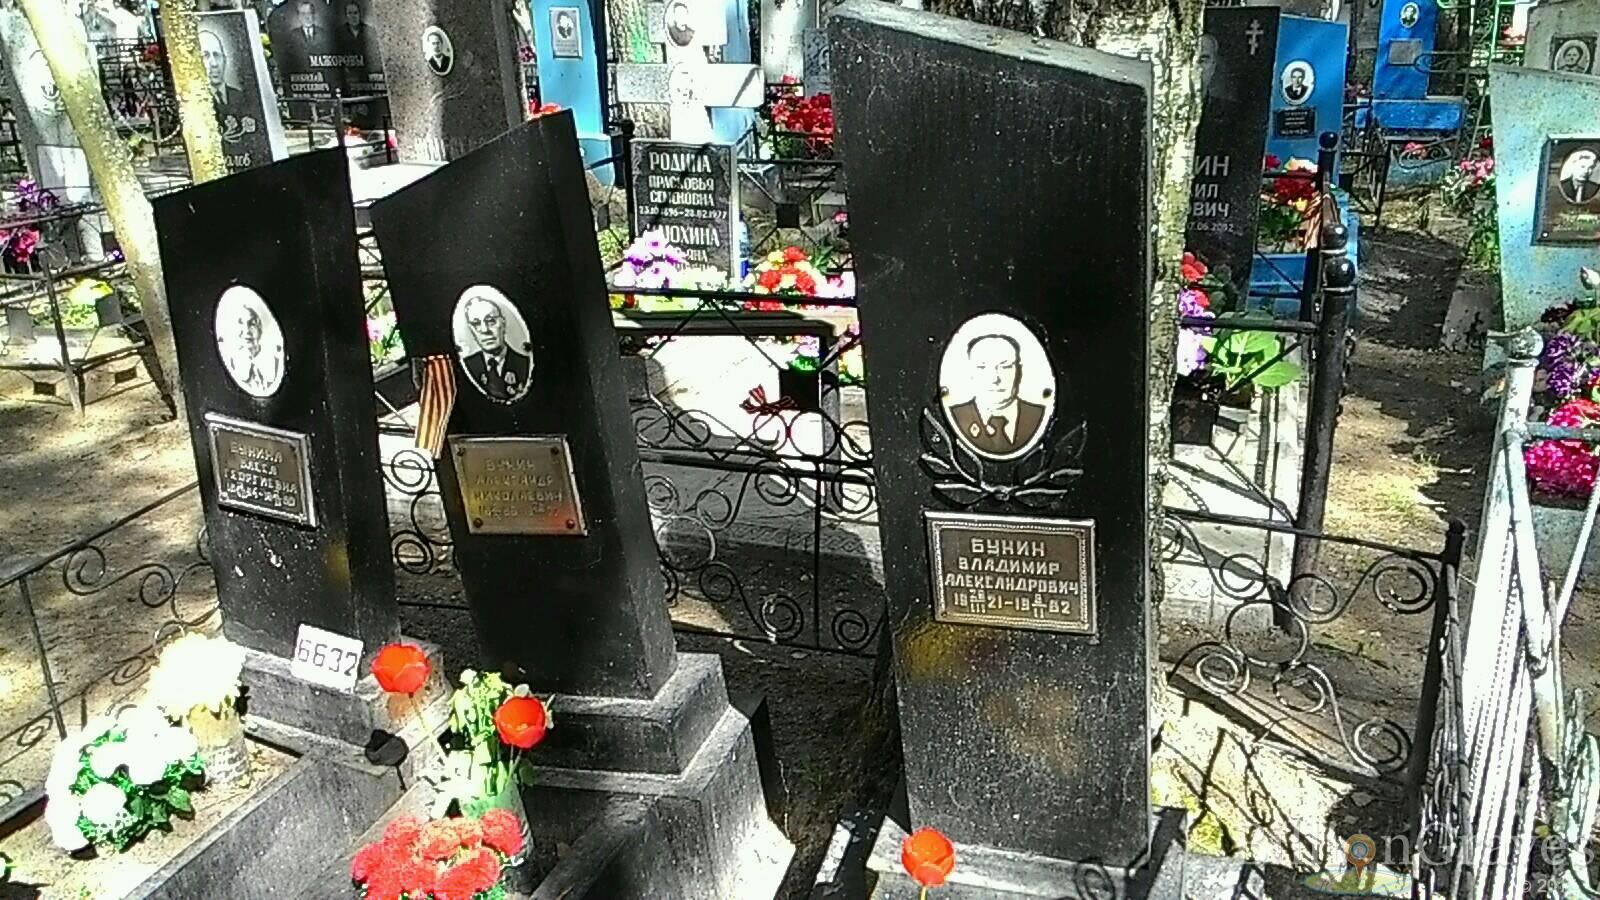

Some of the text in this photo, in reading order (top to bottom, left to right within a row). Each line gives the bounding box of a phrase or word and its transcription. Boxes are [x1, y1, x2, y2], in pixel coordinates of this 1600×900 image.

[648, 151, 712, 173] РОДИНА
[970, 537, 1046, 557] БУНИН
[958, 556, 1060, 576] ВЛАДИМИР
[944, 573, 1079, 595] АЛЕКСАНДРОВИЧ
[298, 638, 358, 677] 6632
